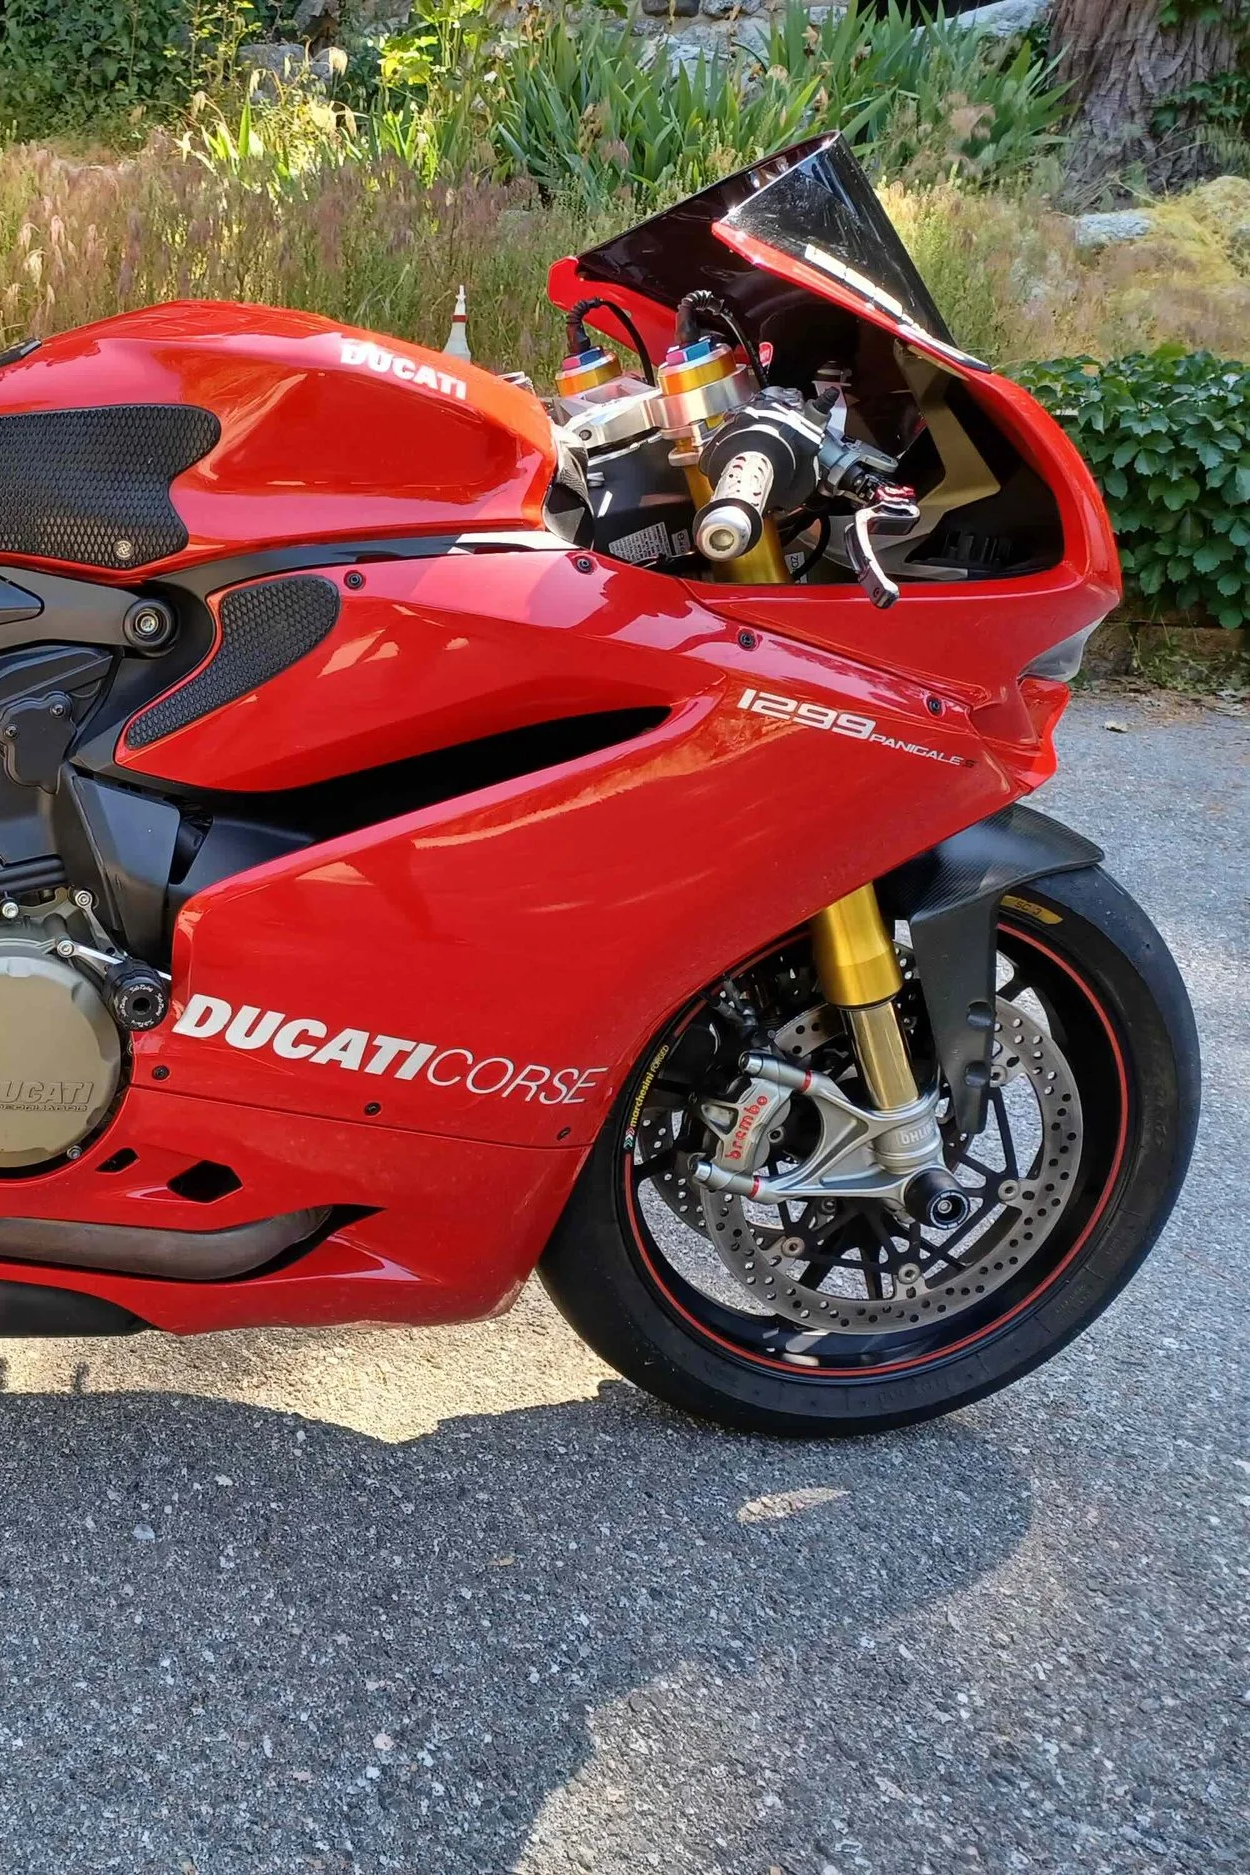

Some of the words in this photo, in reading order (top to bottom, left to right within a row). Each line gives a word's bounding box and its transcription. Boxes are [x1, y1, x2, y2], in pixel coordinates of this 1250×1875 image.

[340, 340, 467, 401] DUCATI
[737, 688, 877, 740] 1299
[869, 733, 964, 766] PANIGALE
[172, 993, 437, 1081] DUCATI
[427, 1048, 609, 1105] CORSE
[630, 1072, 655, 1127] marchesini
[725, 1096, 768, 1160] brembo
